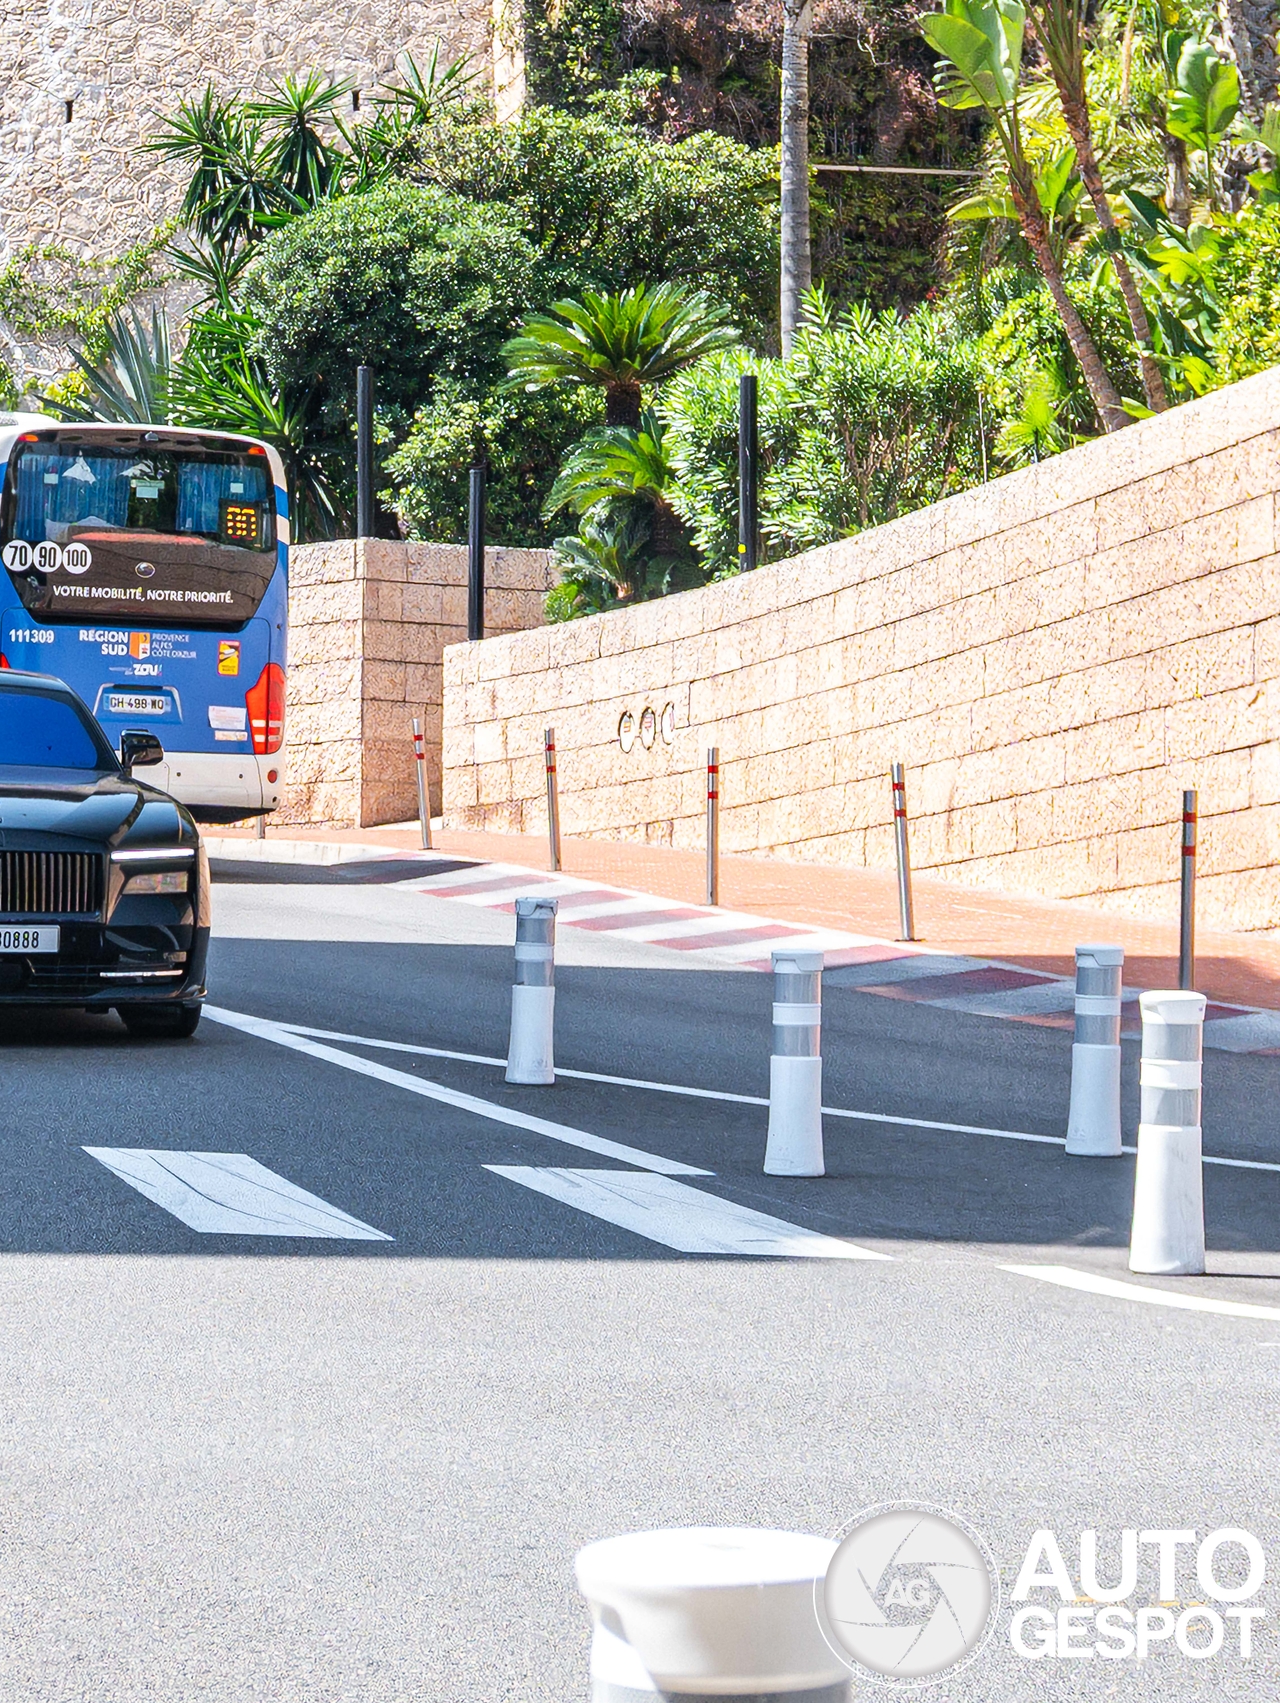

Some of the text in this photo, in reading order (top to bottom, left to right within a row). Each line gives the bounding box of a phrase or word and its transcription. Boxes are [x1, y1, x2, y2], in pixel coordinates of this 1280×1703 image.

[9, 545, 88, 568] 70 90 100
[53, 585, 234, 603] VOTRE MOBILITÉ, NOTRE PRIORITÉ.
[9, 628, 55, 644] 111309
[79, 628, 129, 643] RÉGION
[101, 644, 128, 656] SUD
[133, 663, 163, 677] ZOU!
